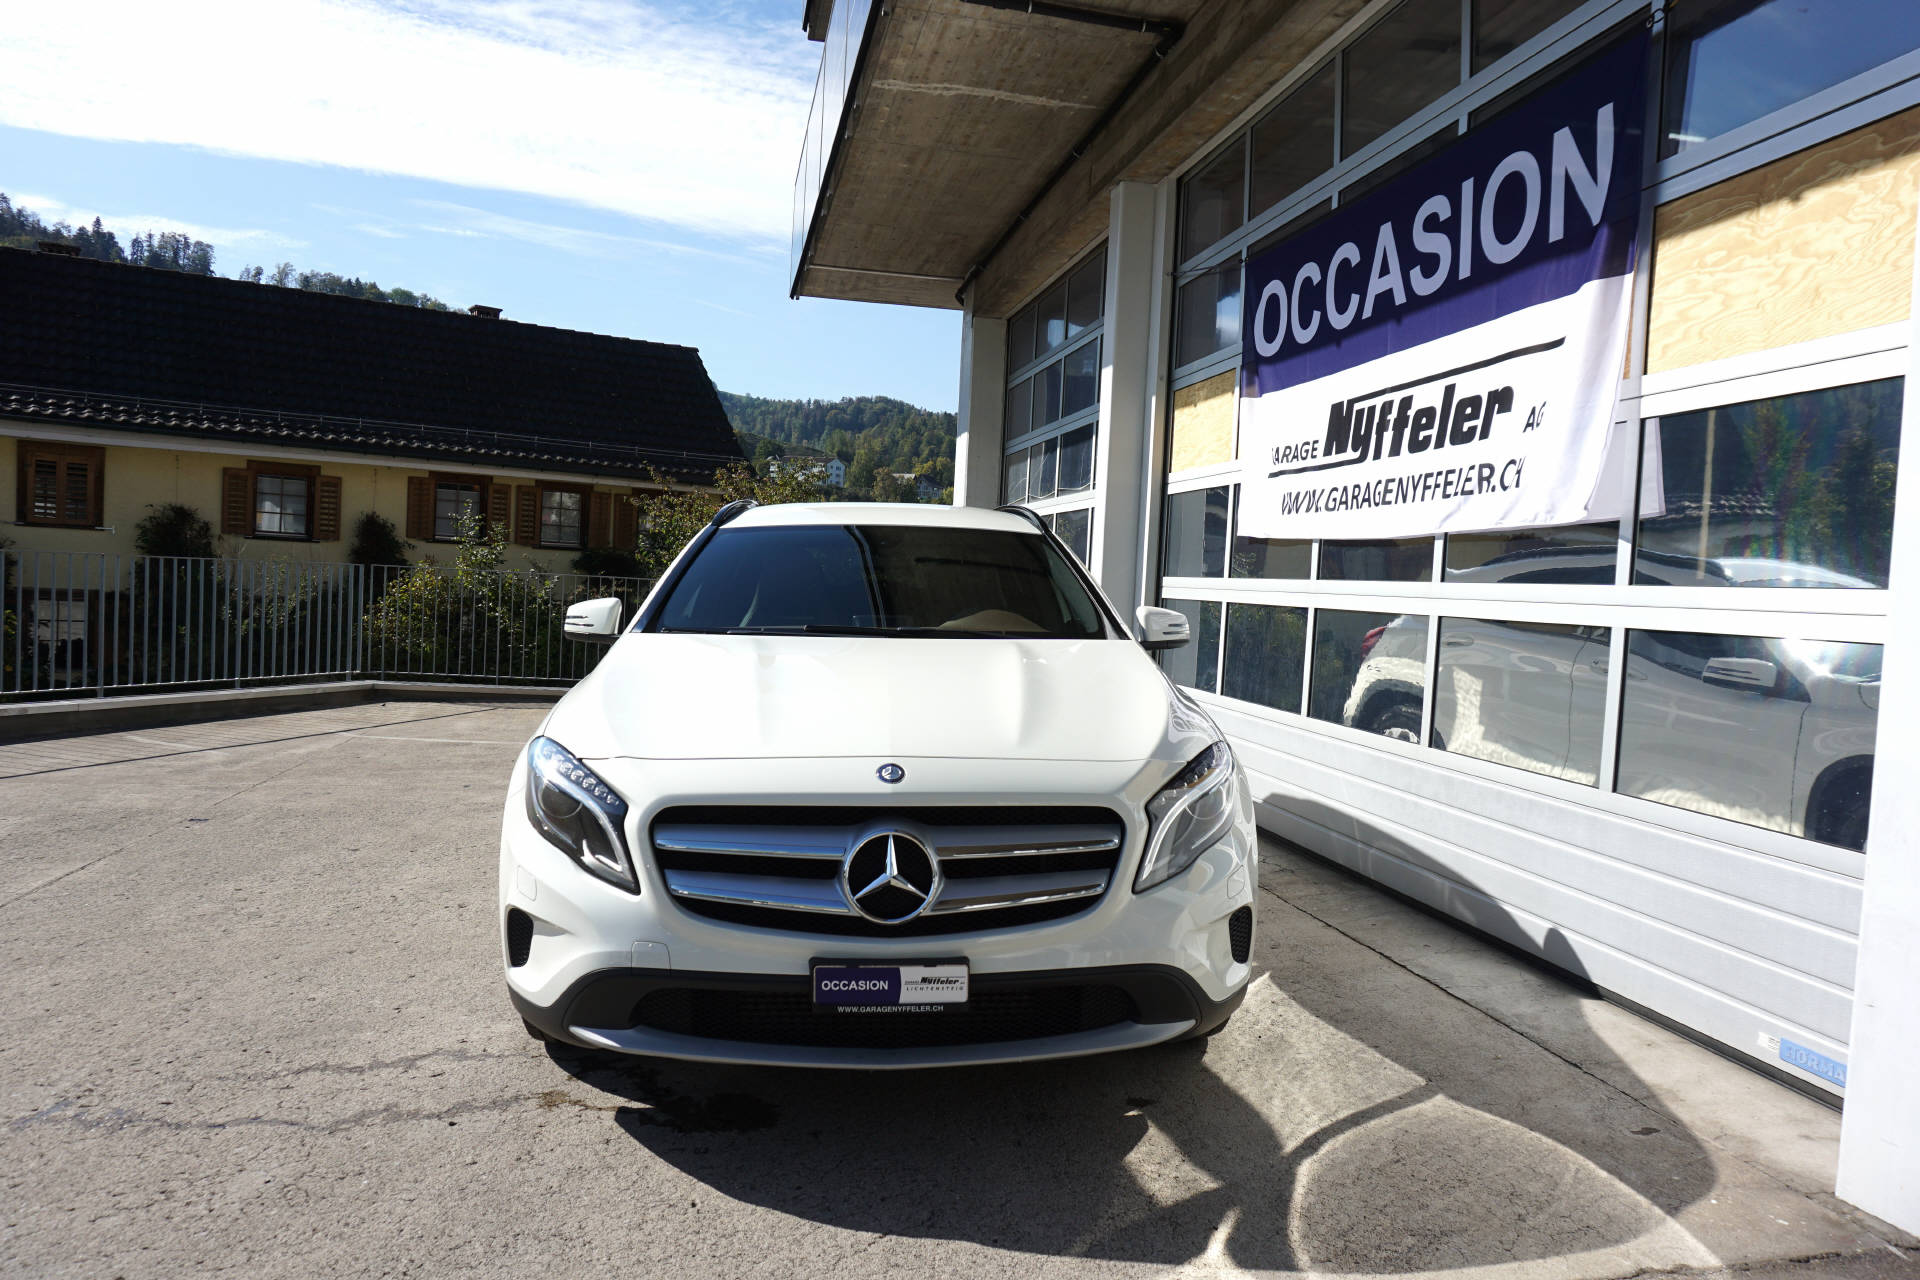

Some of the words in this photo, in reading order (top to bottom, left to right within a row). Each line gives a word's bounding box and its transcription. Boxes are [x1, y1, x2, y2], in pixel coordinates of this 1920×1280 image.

[1254, 102, 1614, 357] OCCASION
[1272, 440, 1320, 465] ARAGE
[1322, 383, 1514, 464] Nyffeler
[821, 980, 889, 991] OCCASION
[837, 1005, 944, 1013] WWW.GARAGENYFFELER.CH
